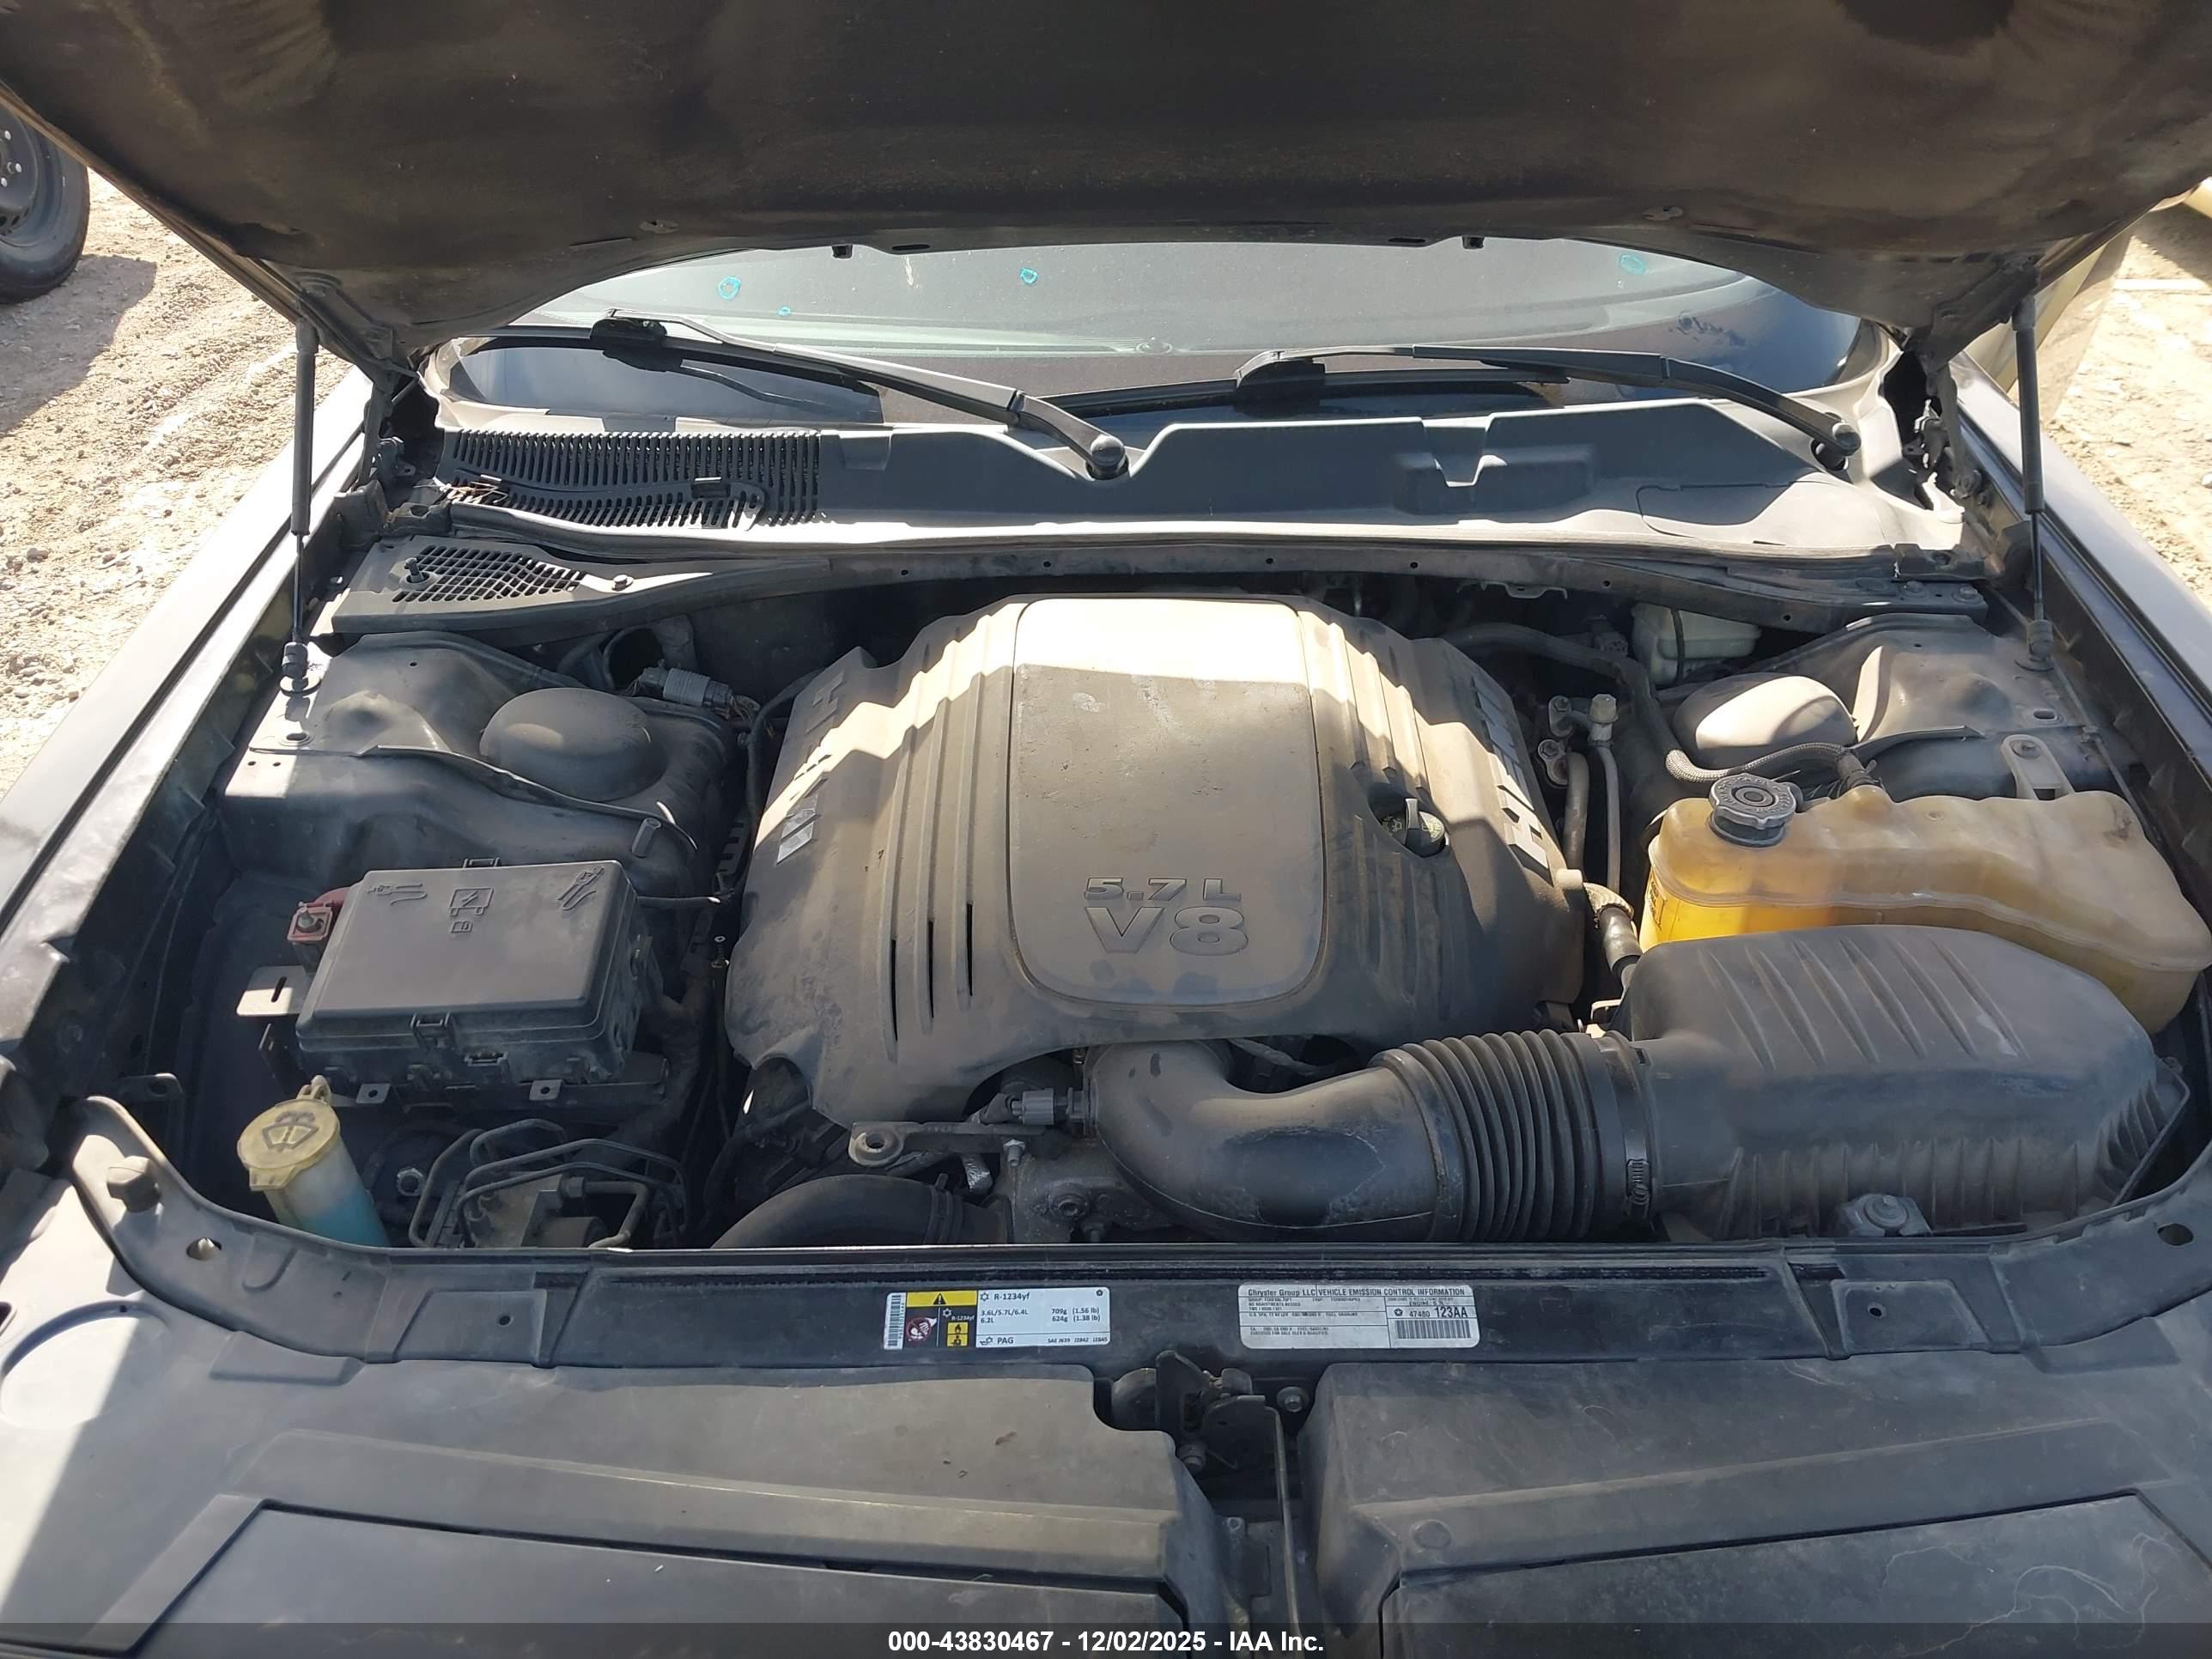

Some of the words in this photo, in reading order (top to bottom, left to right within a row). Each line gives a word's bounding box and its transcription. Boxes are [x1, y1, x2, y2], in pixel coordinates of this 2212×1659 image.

[1084, 877, 1242, 902] 5.7L
[1085, 906, 1249, 957] V8
[994, 1291, 1030, 1301] R-1234yf
[1248, 1289, 1277, 1297] Chrysler
[1279, 1289, 1300, 1297] Group
[1091, 1306, 1100, 1315] lb)
[1435, 1307, 1468, 1318] 123AA
[1091, 1314, 1101, 1322] lb)
